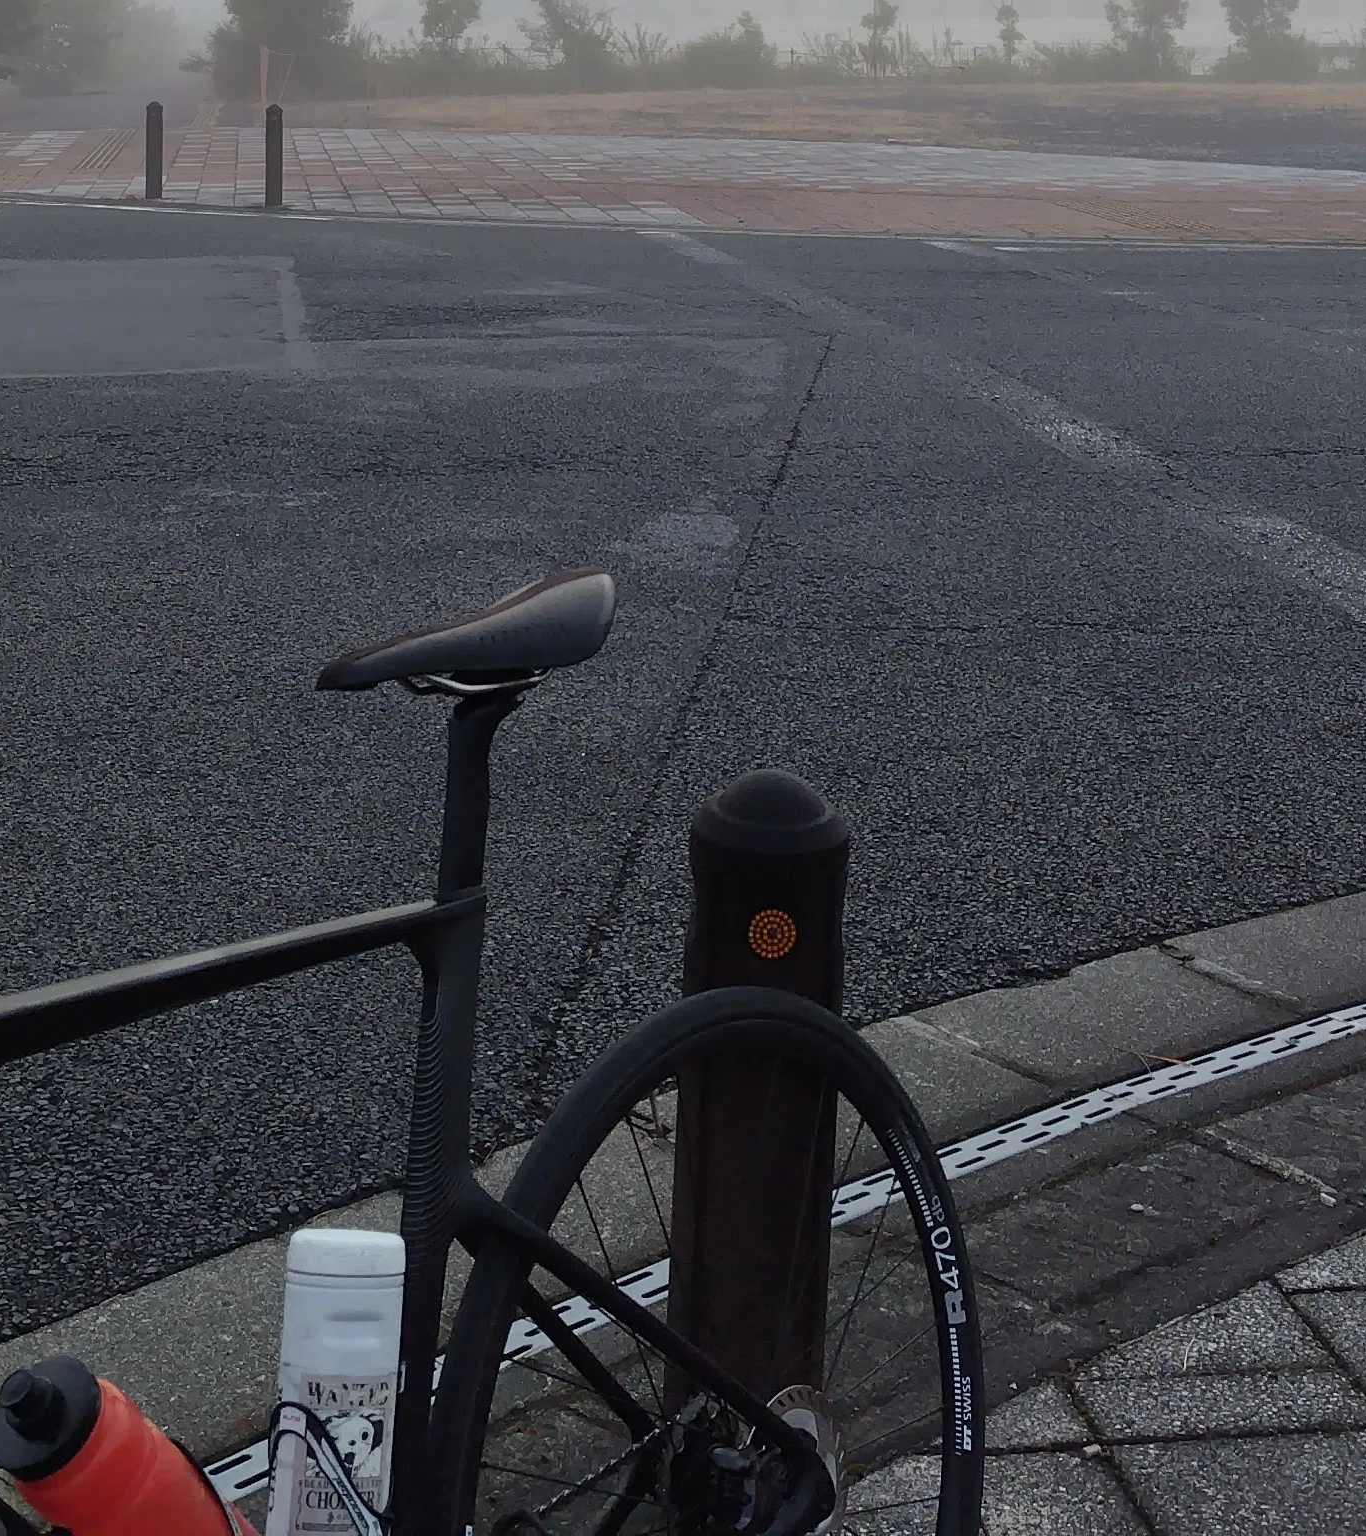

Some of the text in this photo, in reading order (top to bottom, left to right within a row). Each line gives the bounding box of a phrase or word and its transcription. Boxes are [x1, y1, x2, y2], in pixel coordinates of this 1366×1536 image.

[307, 1381, 390, 1406] WANTED
[962, 1376, 972, 1451] DT SWISS
[305, 1490, 375, 1510] CHOER
